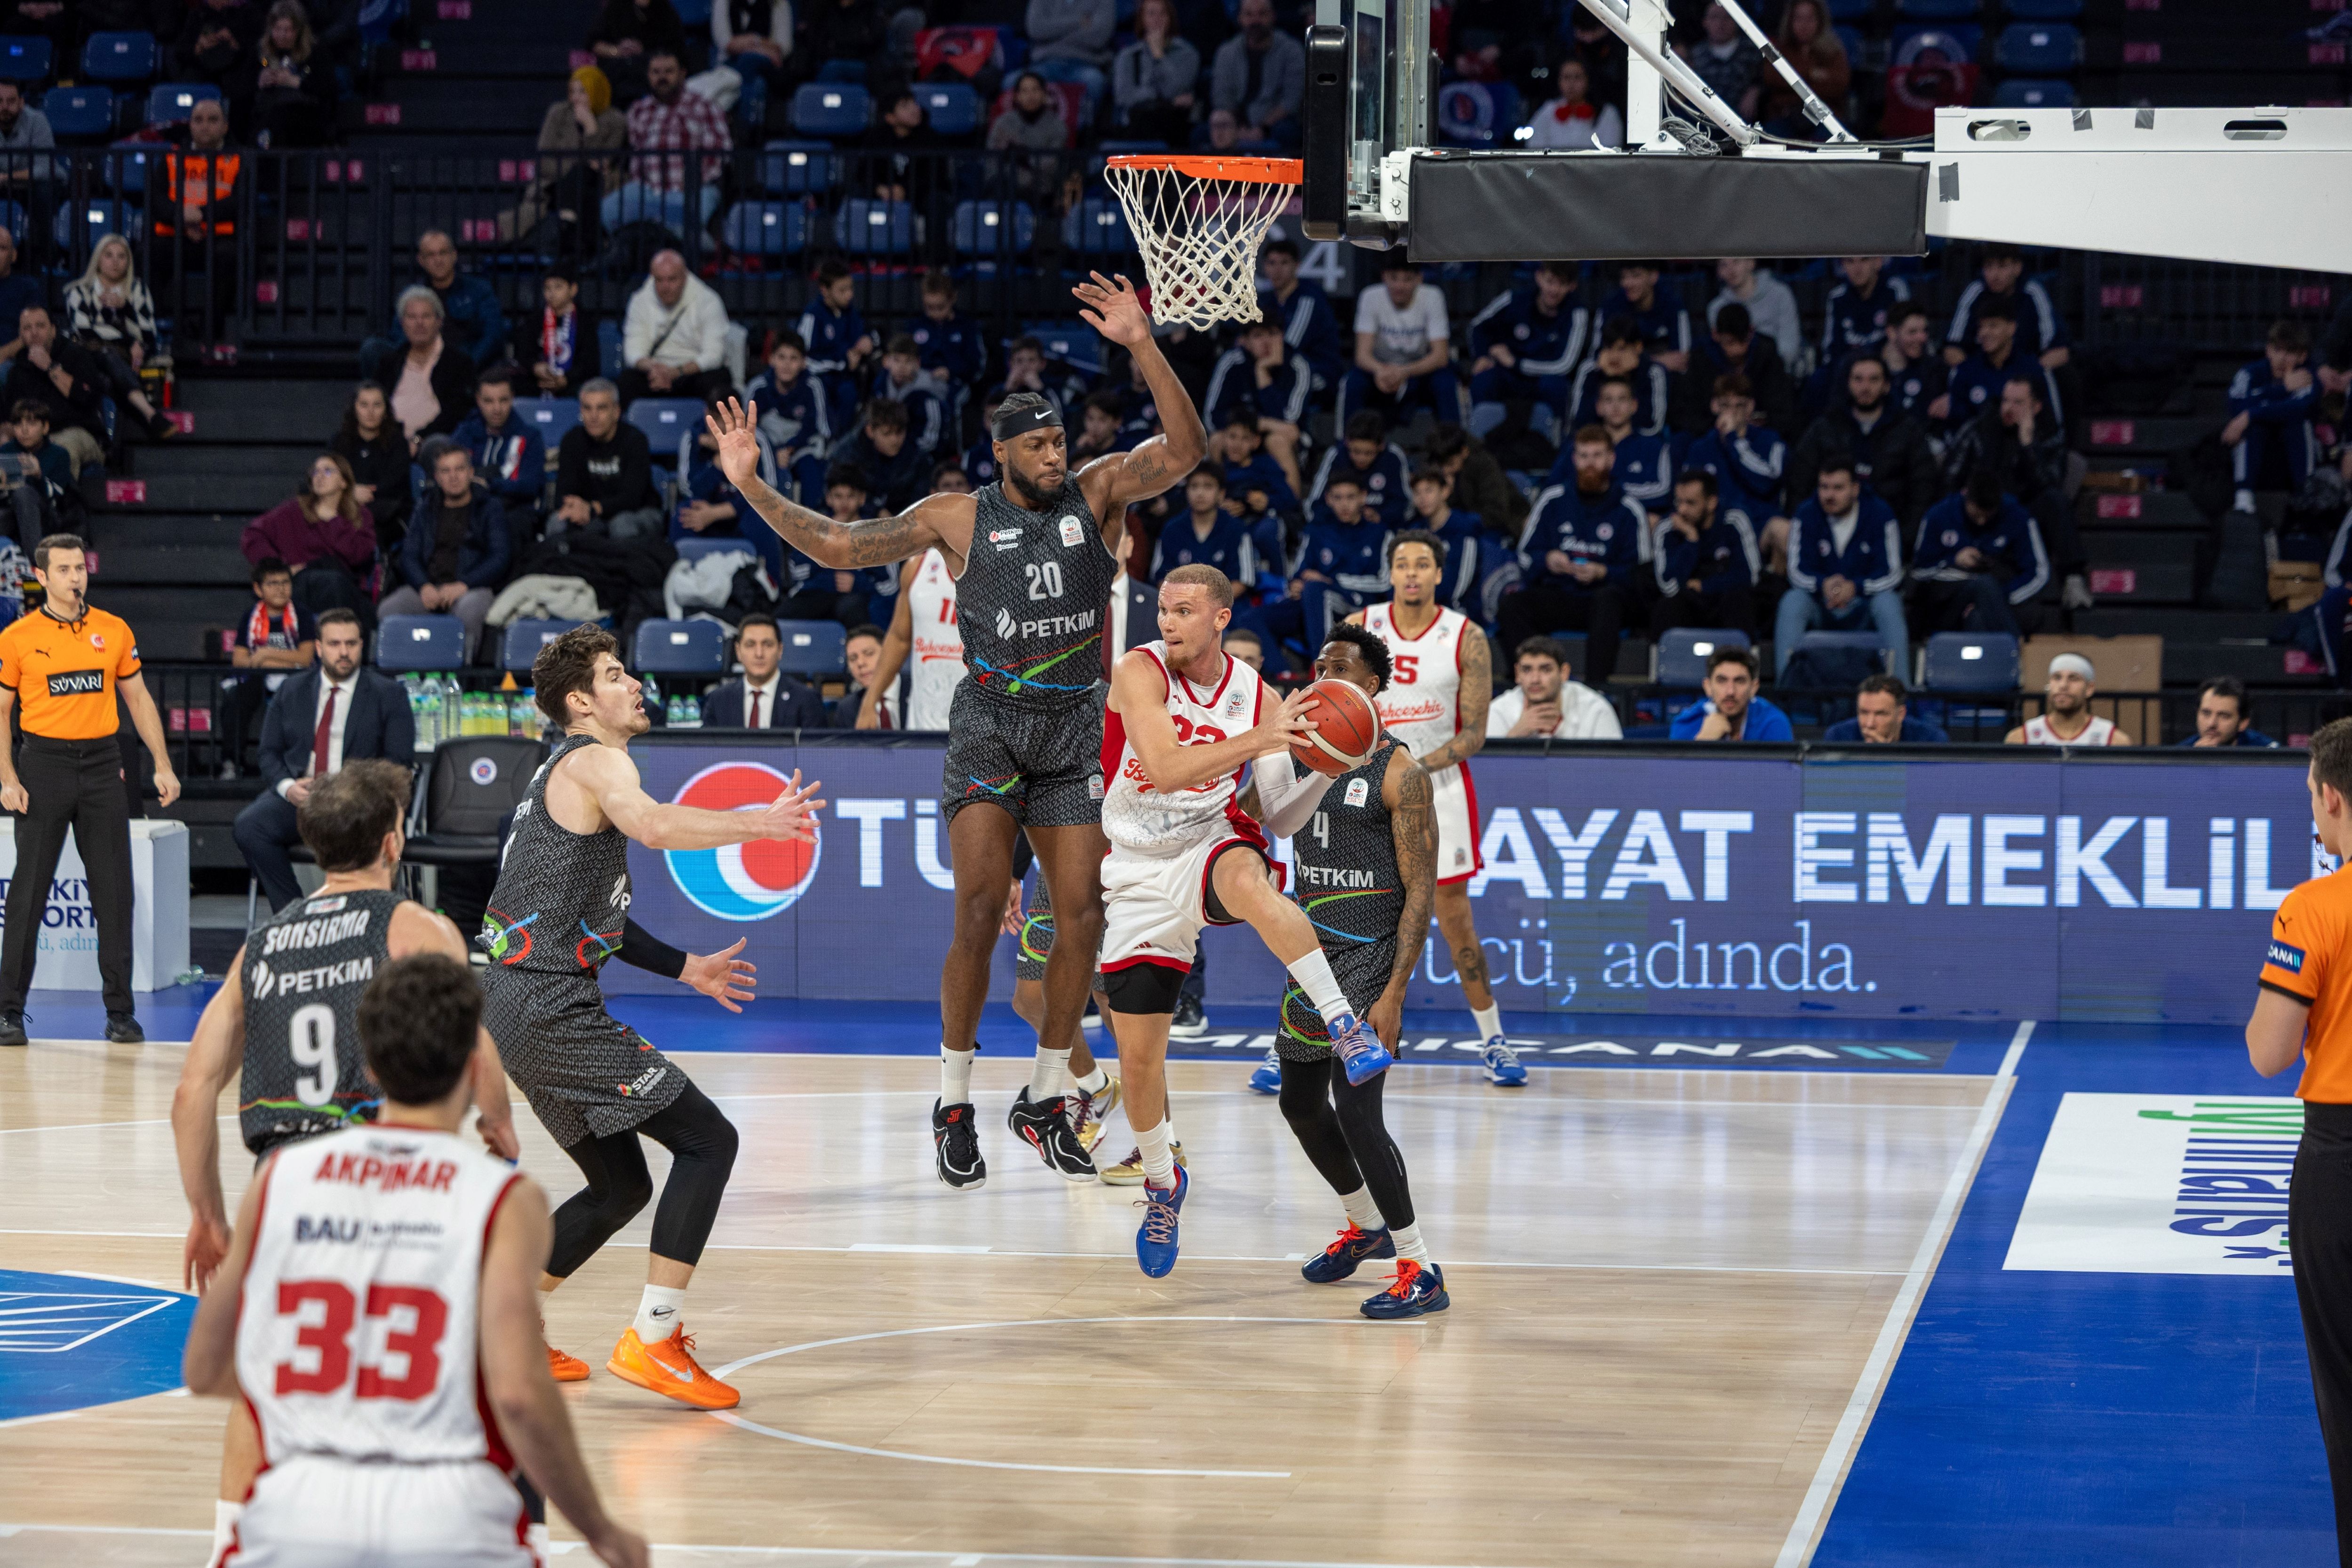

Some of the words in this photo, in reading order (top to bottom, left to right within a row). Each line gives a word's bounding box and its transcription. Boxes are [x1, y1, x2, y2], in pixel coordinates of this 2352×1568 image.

[1026, 561, 1064, 601] 20
[1394, 654, 1419, 685] 5
[1313, 811, 1329, 849] 4
[1467, 807, 1754, 901] AYAT
[1603, 918, 1877, 993] adında.
[288, 1002, 338, 1107] 9
[632, 1067, 658, 1091] STAR
[294, 1217, 362, 1245] BAU
[274, 1280, 450, 1401] 33
